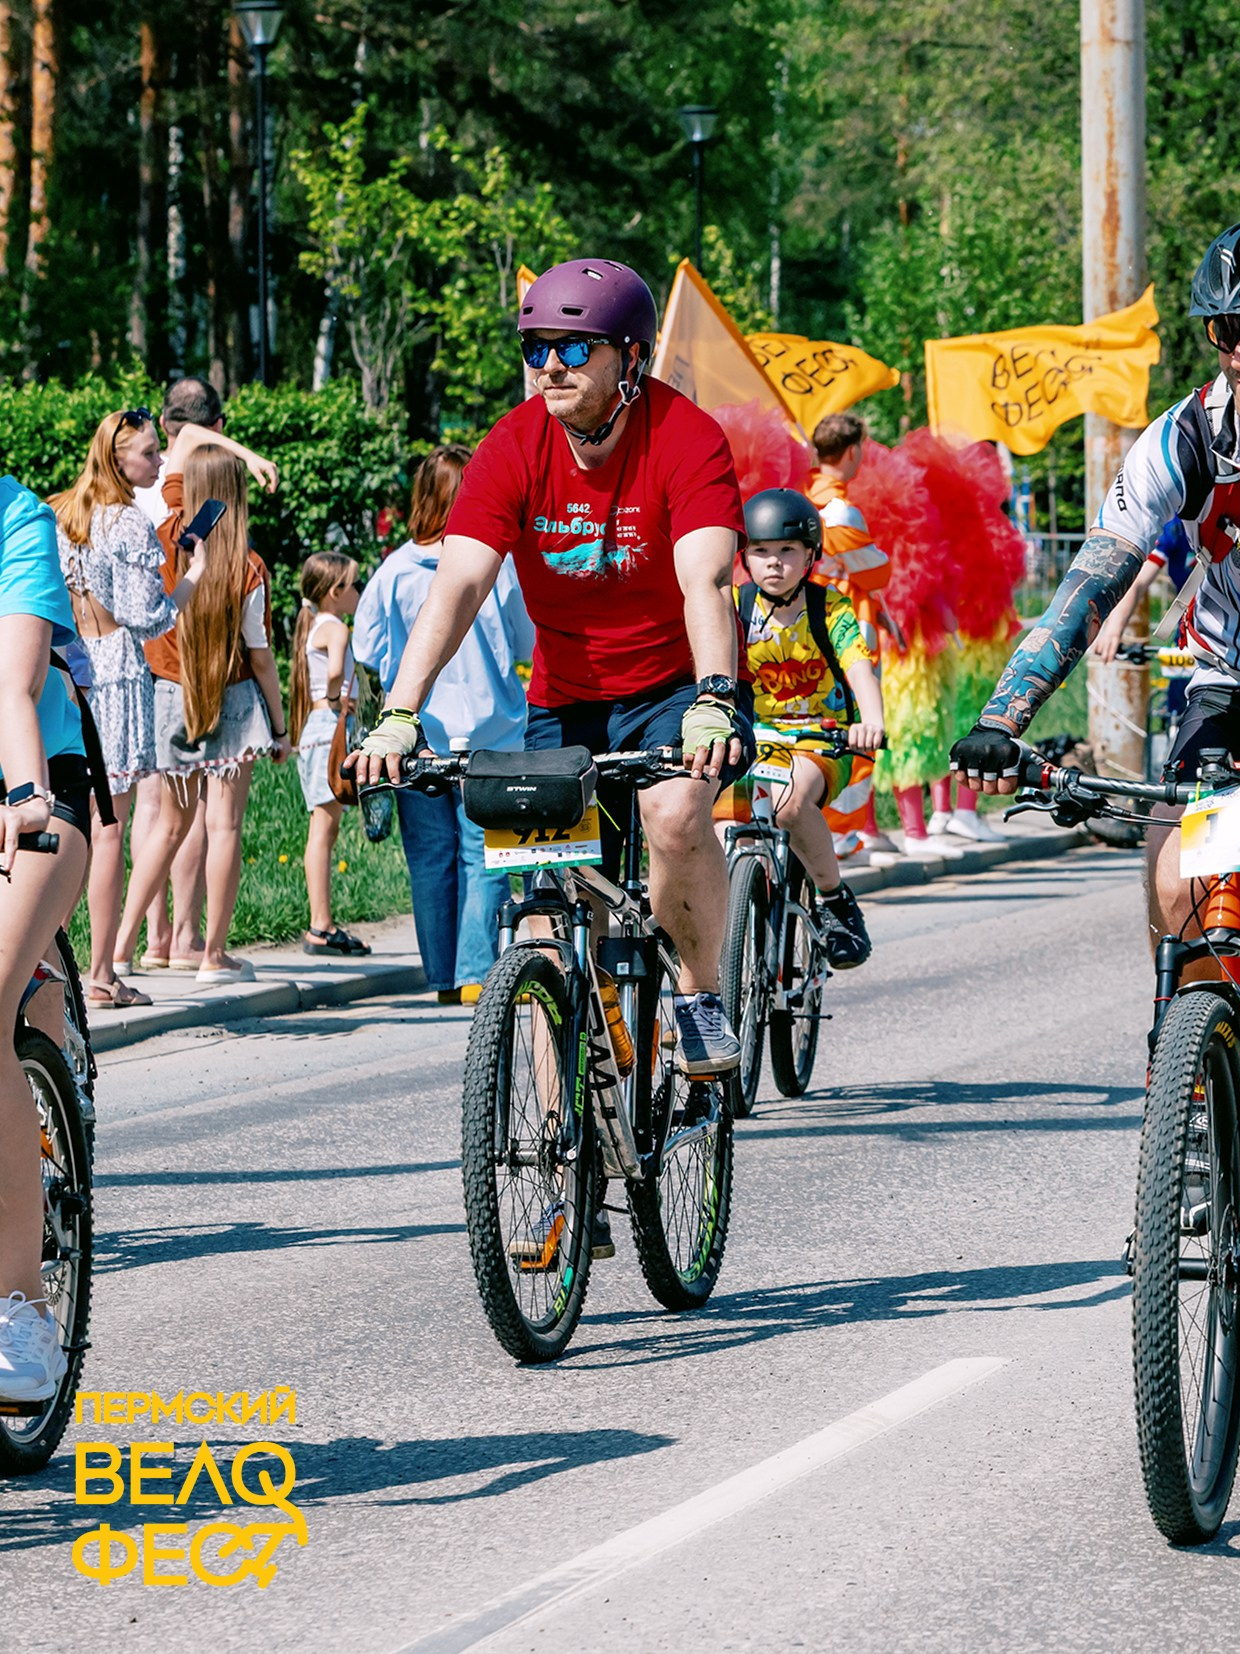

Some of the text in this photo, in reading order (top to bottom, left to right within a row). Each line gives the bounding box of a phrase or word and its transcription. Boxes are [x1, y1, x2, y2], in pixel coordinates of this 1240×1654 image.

[1115, 463, 1128, 512] ANO
[566, 503, 591, 514] 5642
[757, 662, 823, 695] BANG
